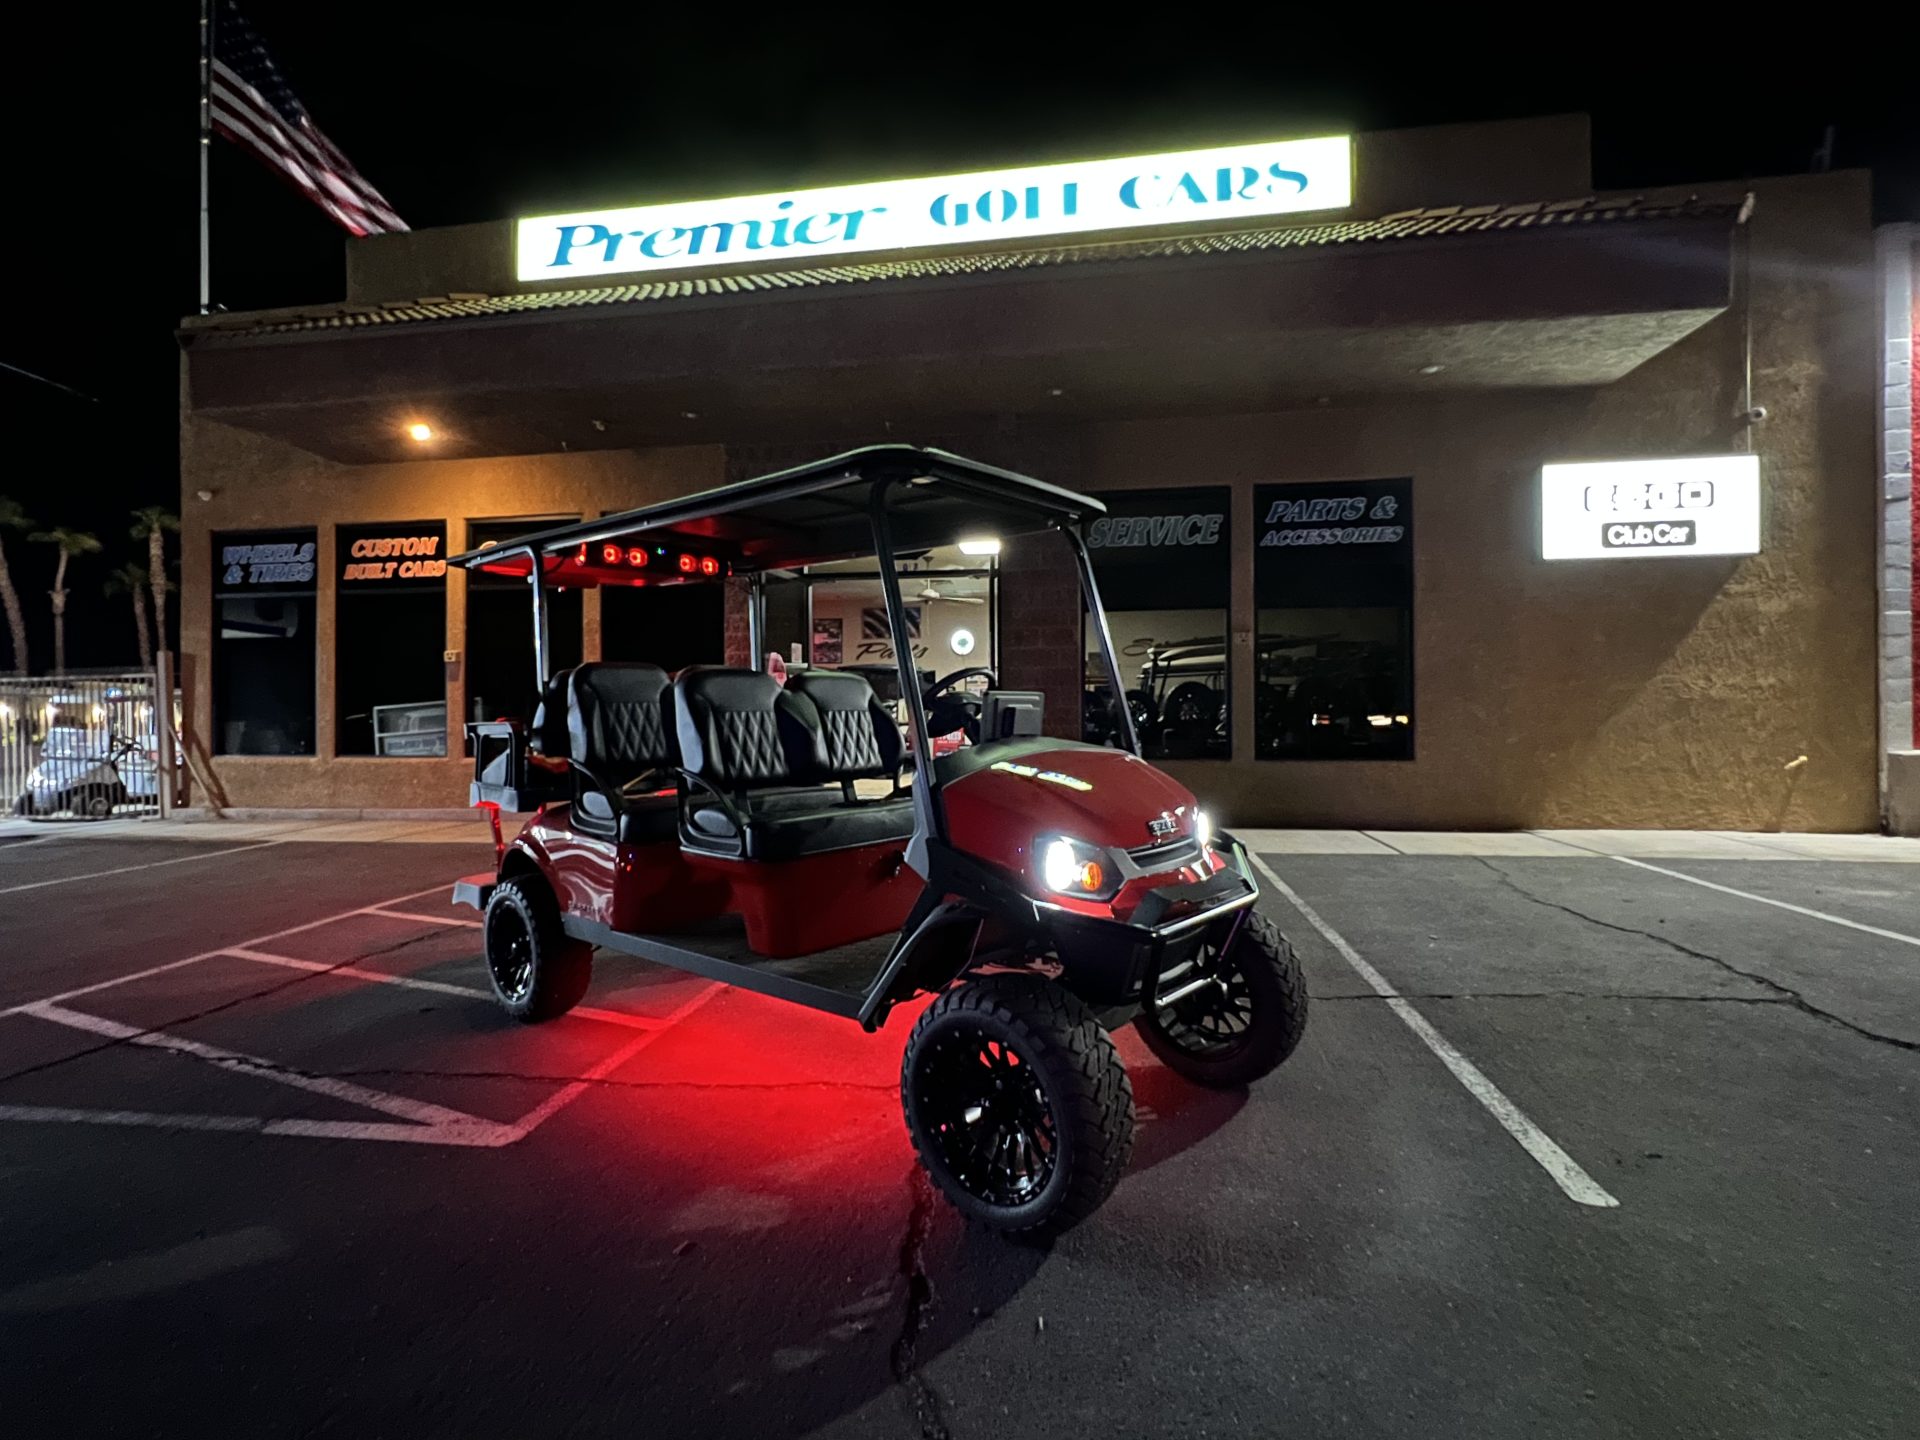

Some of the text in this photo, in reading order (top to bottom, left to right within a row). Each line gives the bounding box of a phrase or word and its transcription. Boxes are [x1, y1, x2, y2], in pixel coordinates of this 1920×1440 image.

[547, 198, 887, 267] Premier
[1118, 162, 1309, 210] CARS
[1265, 496, 1398, 523] PARTS &
[1087, 514, 1224, 548] SERVICE
[1260, 526, 1404, 547] ACCESSORIES
[1607, 523, 1689, 546] Club Car
[223, 543, 314, 564] WHEELS
[352, 537, 438, 557] CUSTOM
[223, 562, 315, 584] & TIRES
[344, 561, 446, 579] BUILT CARS
[855, 642, 929, 661] Pas
